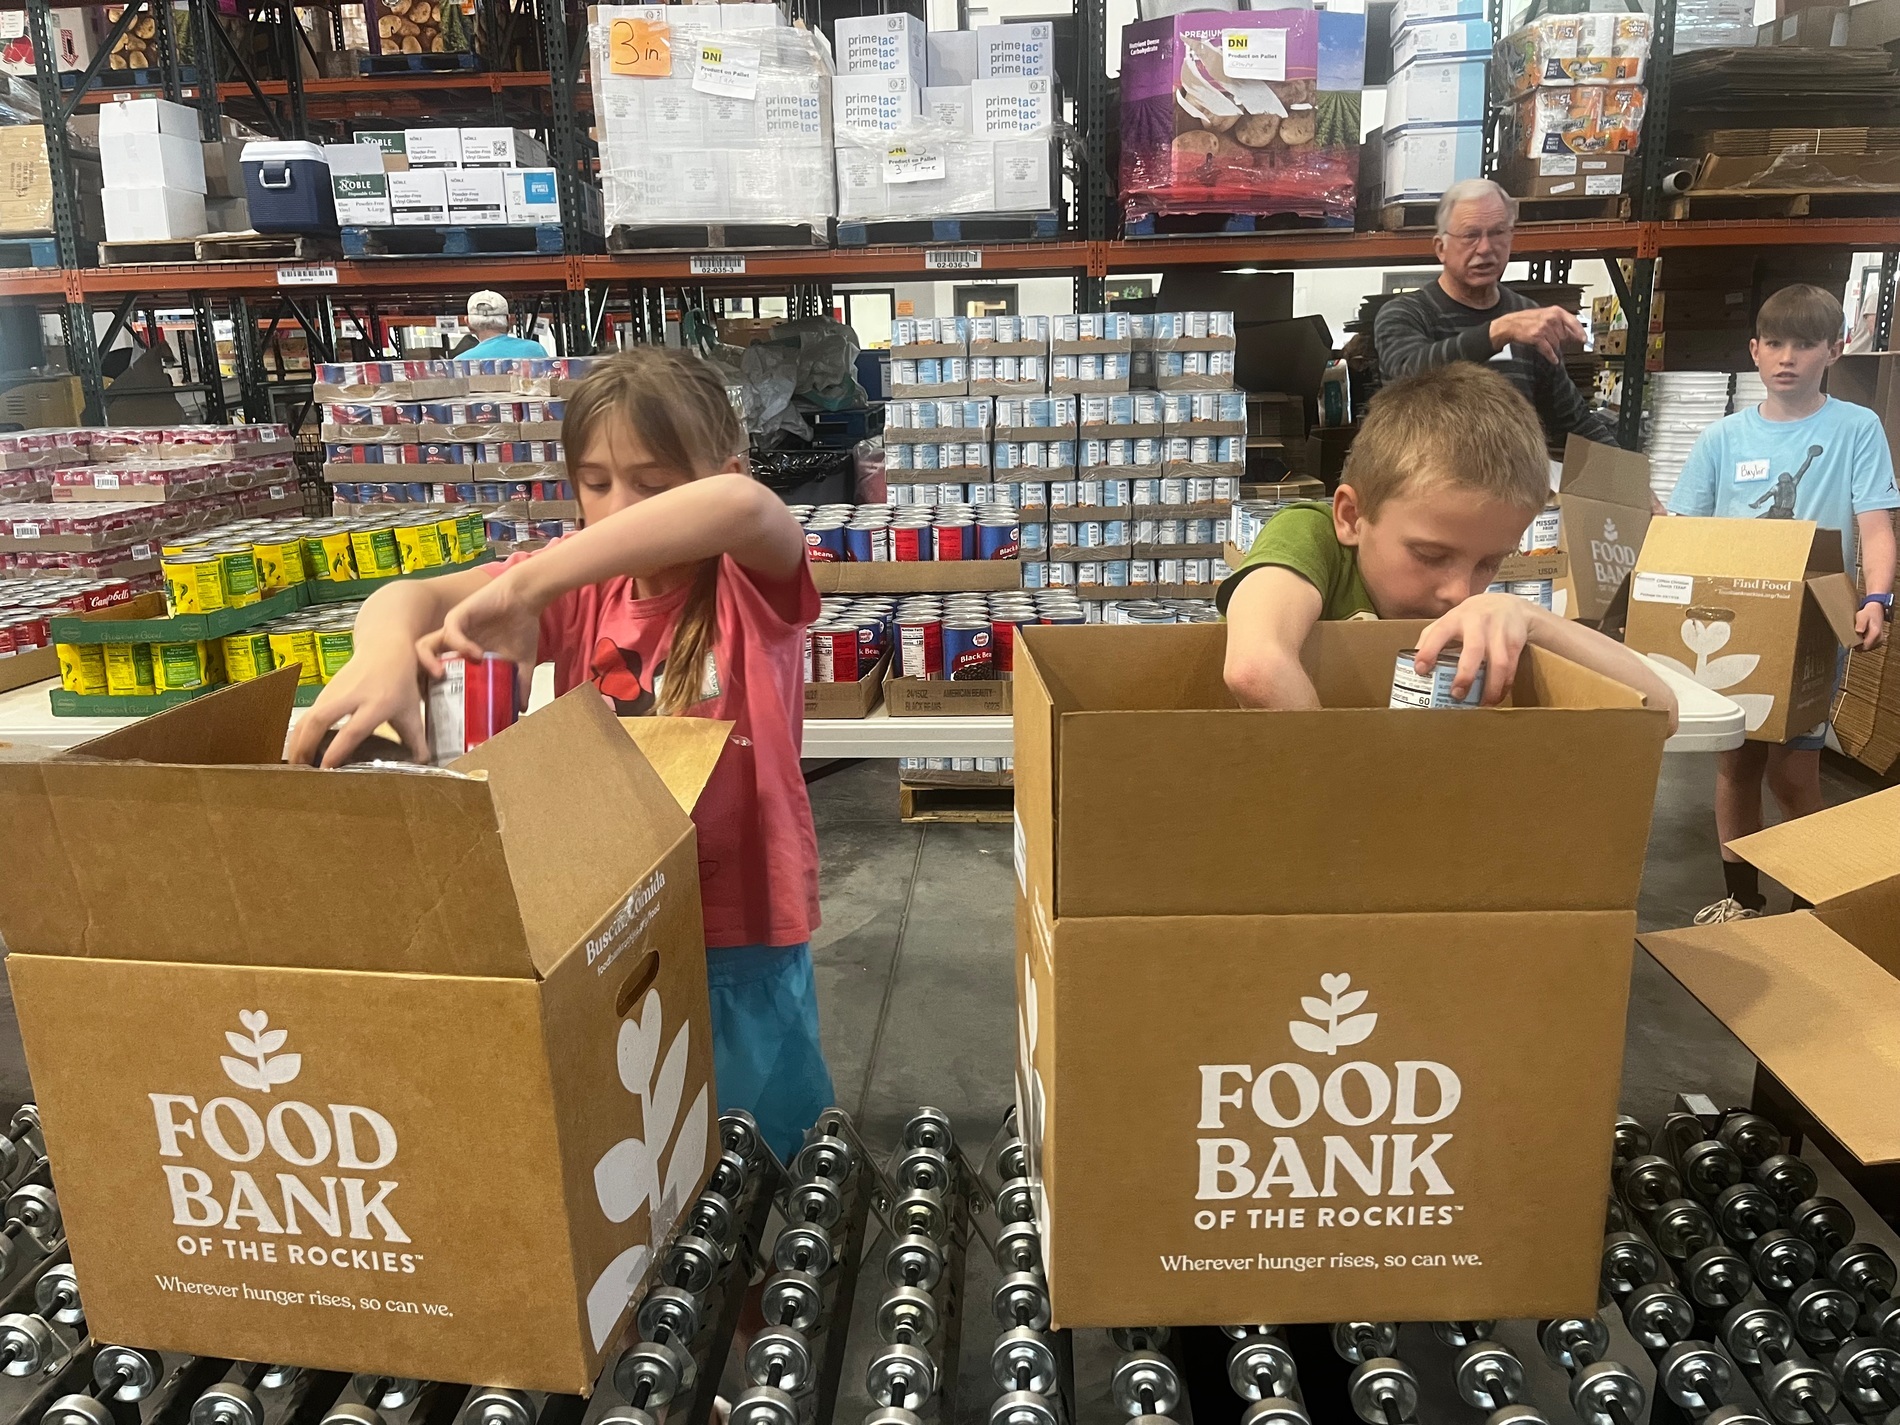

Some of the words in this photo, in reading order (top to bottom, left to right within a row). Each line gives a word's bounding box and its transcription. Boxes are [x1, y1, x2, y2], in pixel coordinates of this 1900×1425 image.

[613, 21, 640, 66] 3
[1228, 39, 1248, 48] DNI
[702, 51, 722, 62] DNI
[701, 65, 723, 73] Product
[338, 179, 371, 192] NOBLE
[1741, 464, 1765, 479] Baylor
[813, 550, 834, 558] Beans
[1590, 540, 1636, 566] FOOD
[1594, 562, 1632, 585] BAN
[1733, 578, 1759, 589] Find
[1761, 579, 1791, 591] Food
[960, 651, 981, 663] Black
[944, 689, 971, 698] AMERICAN
[971, 688, 993, 697] BEAUTY
[1419, 697, 1430, 706] 60
[905, 702, 922, 712] BLACK
[627, 870, 666, 920] Comida
[1197, 1060, 1462, 1129] FOOD
[148, 1092, 398, 1170] FOOD
[1195, 1133, 1455, 1200] BANK
[162, 1164, 412, 1244] BANK
[1194, 1208, 1236, 1230] OF
[1248, 1207, 1305, 1229] THE
[176, 1235, 213, 1256] OF
[222, 1238, 278, 1263] THE
[1160, 1254, 1254, 1272] Wherever
[1258, 1252, 1326, 1271] hunger
[1330, 1251, 1379, 1269] rises,
[1384, 1254, 1406, 1267] so
[1411, 1253, 1446, 1267] can
[1451, 1253, 1483, 1267] we.
[154, 1274, 239, 1298] Wherever
[242, 1282, 304, 1306] hunger
[309, 1289, 356, 1311] rises,
[360, 1295, 382, 1311] so
[386, 1298, 419, 1315] can
[422, 1302, 454, 1318] we.
